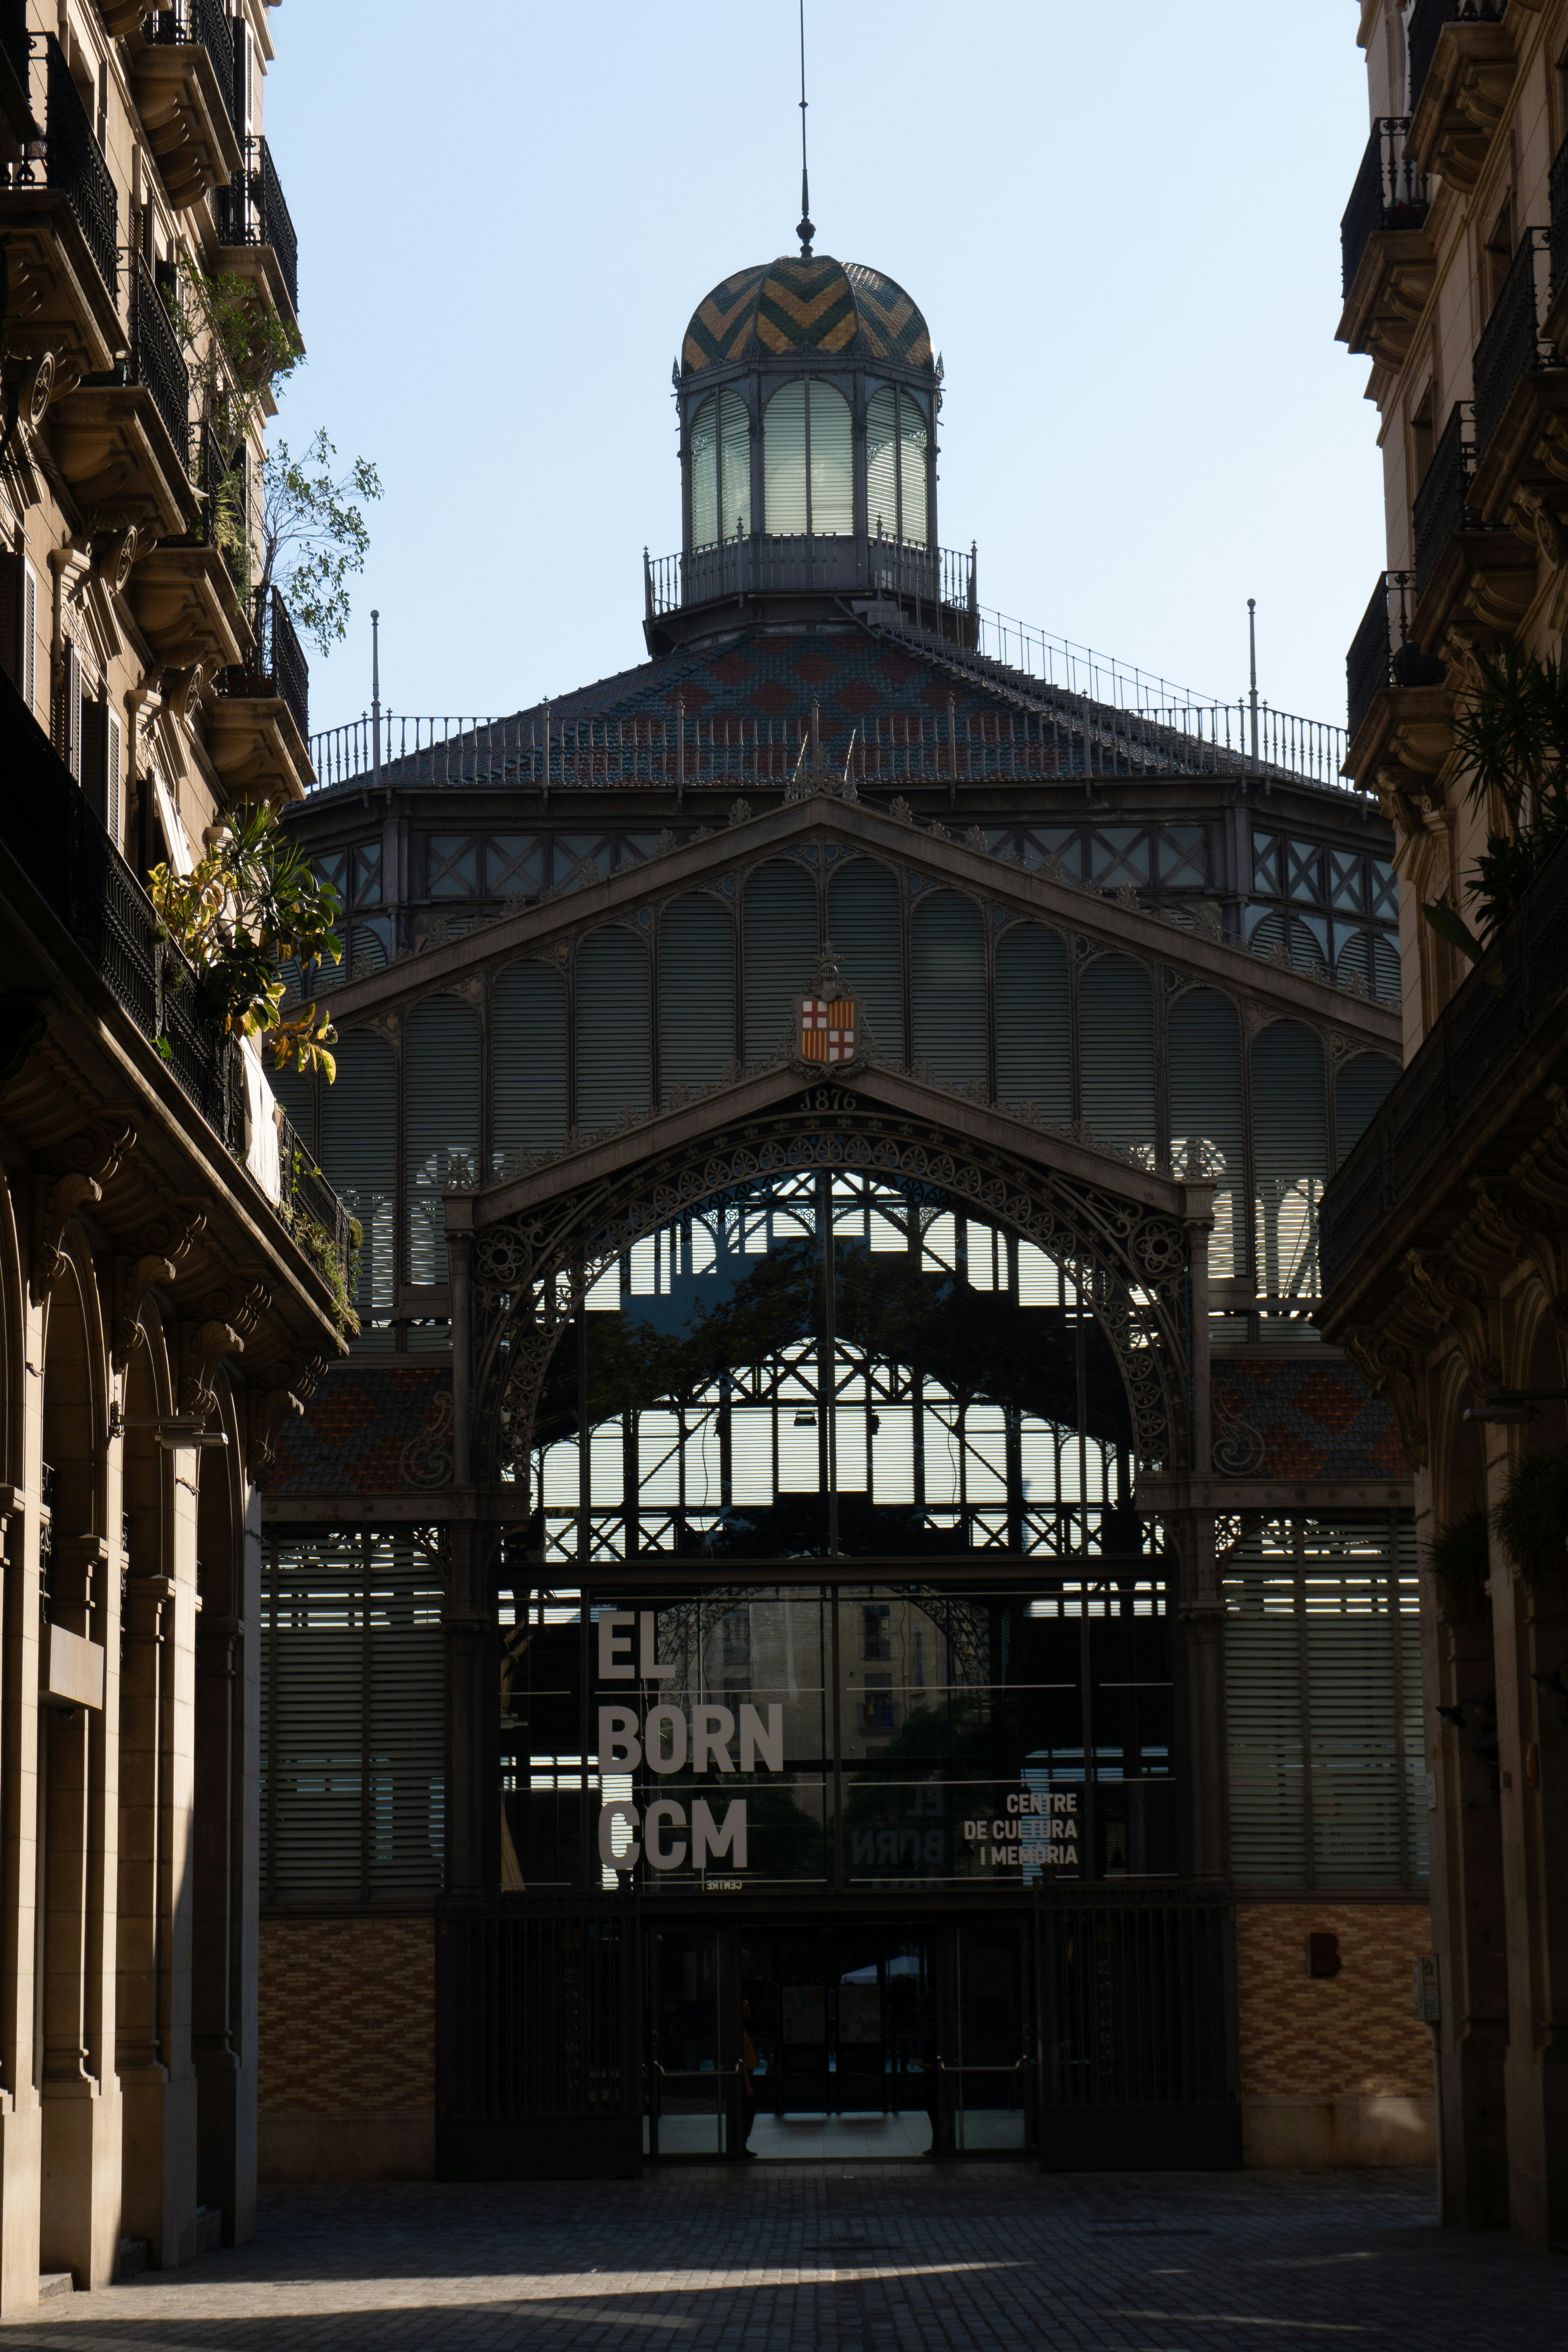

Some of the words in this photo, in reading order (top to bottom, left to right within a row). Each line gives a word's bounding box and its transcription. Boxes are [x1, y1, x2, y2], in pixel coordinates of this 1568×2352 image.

[800, 1089, 857, 1111] 1876
[598, 1611, 676, 1679] EL
[598, 1703, 784, 1774] BORN
[1006, 1793, 1077, 1814] CENTRE
[598, 1799, 748, 1870] CCM
[964, 1821, 987, 1839] DE
[993, 1819, 1078, 1839] CULTURA
[981, 1847, 985, 1865] I
[991, 1842, 1078, 1865] MEMÒRIA
